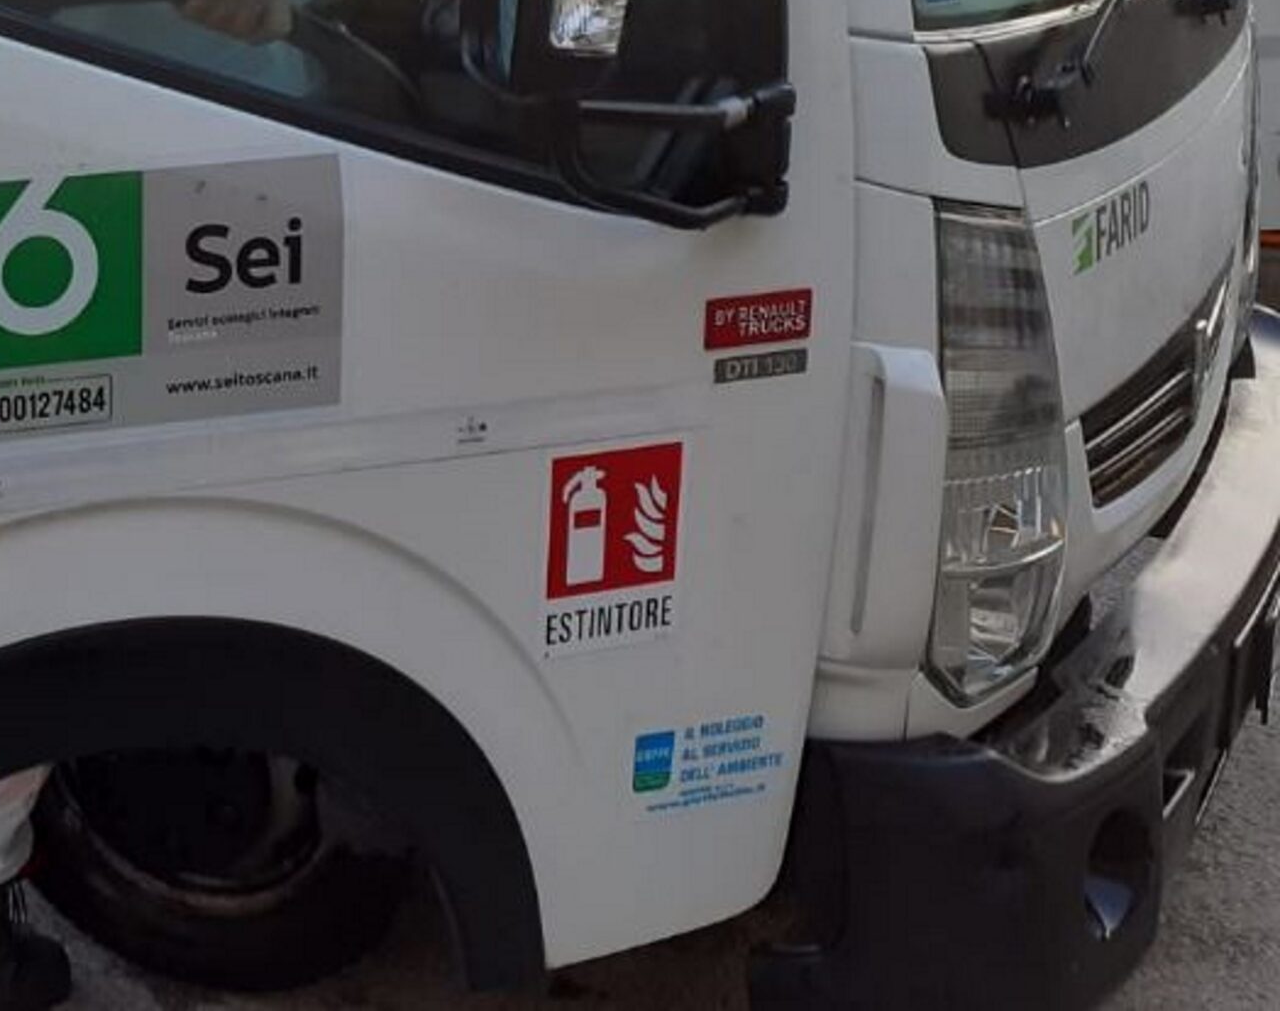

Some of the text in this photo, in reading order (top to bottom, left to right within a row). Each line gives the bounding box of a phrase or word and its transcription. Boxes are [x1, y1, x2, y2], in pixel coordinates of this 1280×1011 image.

[1096, 180, 1150, 264] FARID
[185, 217, 303, 294] Sei
[714, 309, 735, 327] BY
[738, 299, 806, 322] RENAULT
[739, 315, 806, 337] TRUCKS
[166, 365, 319, 394] www.seitoscana.it
[725, 358, 758, 379] DTI
[546, 596, 672, 645] ESTINTORE
[700, 715, 764, 737] NOLEGGIO
[682, 748, 699, 761] AL
[703, 738, 761, 757] SERVIZIO
[717, 752, 784, 775] AMBIENTE
